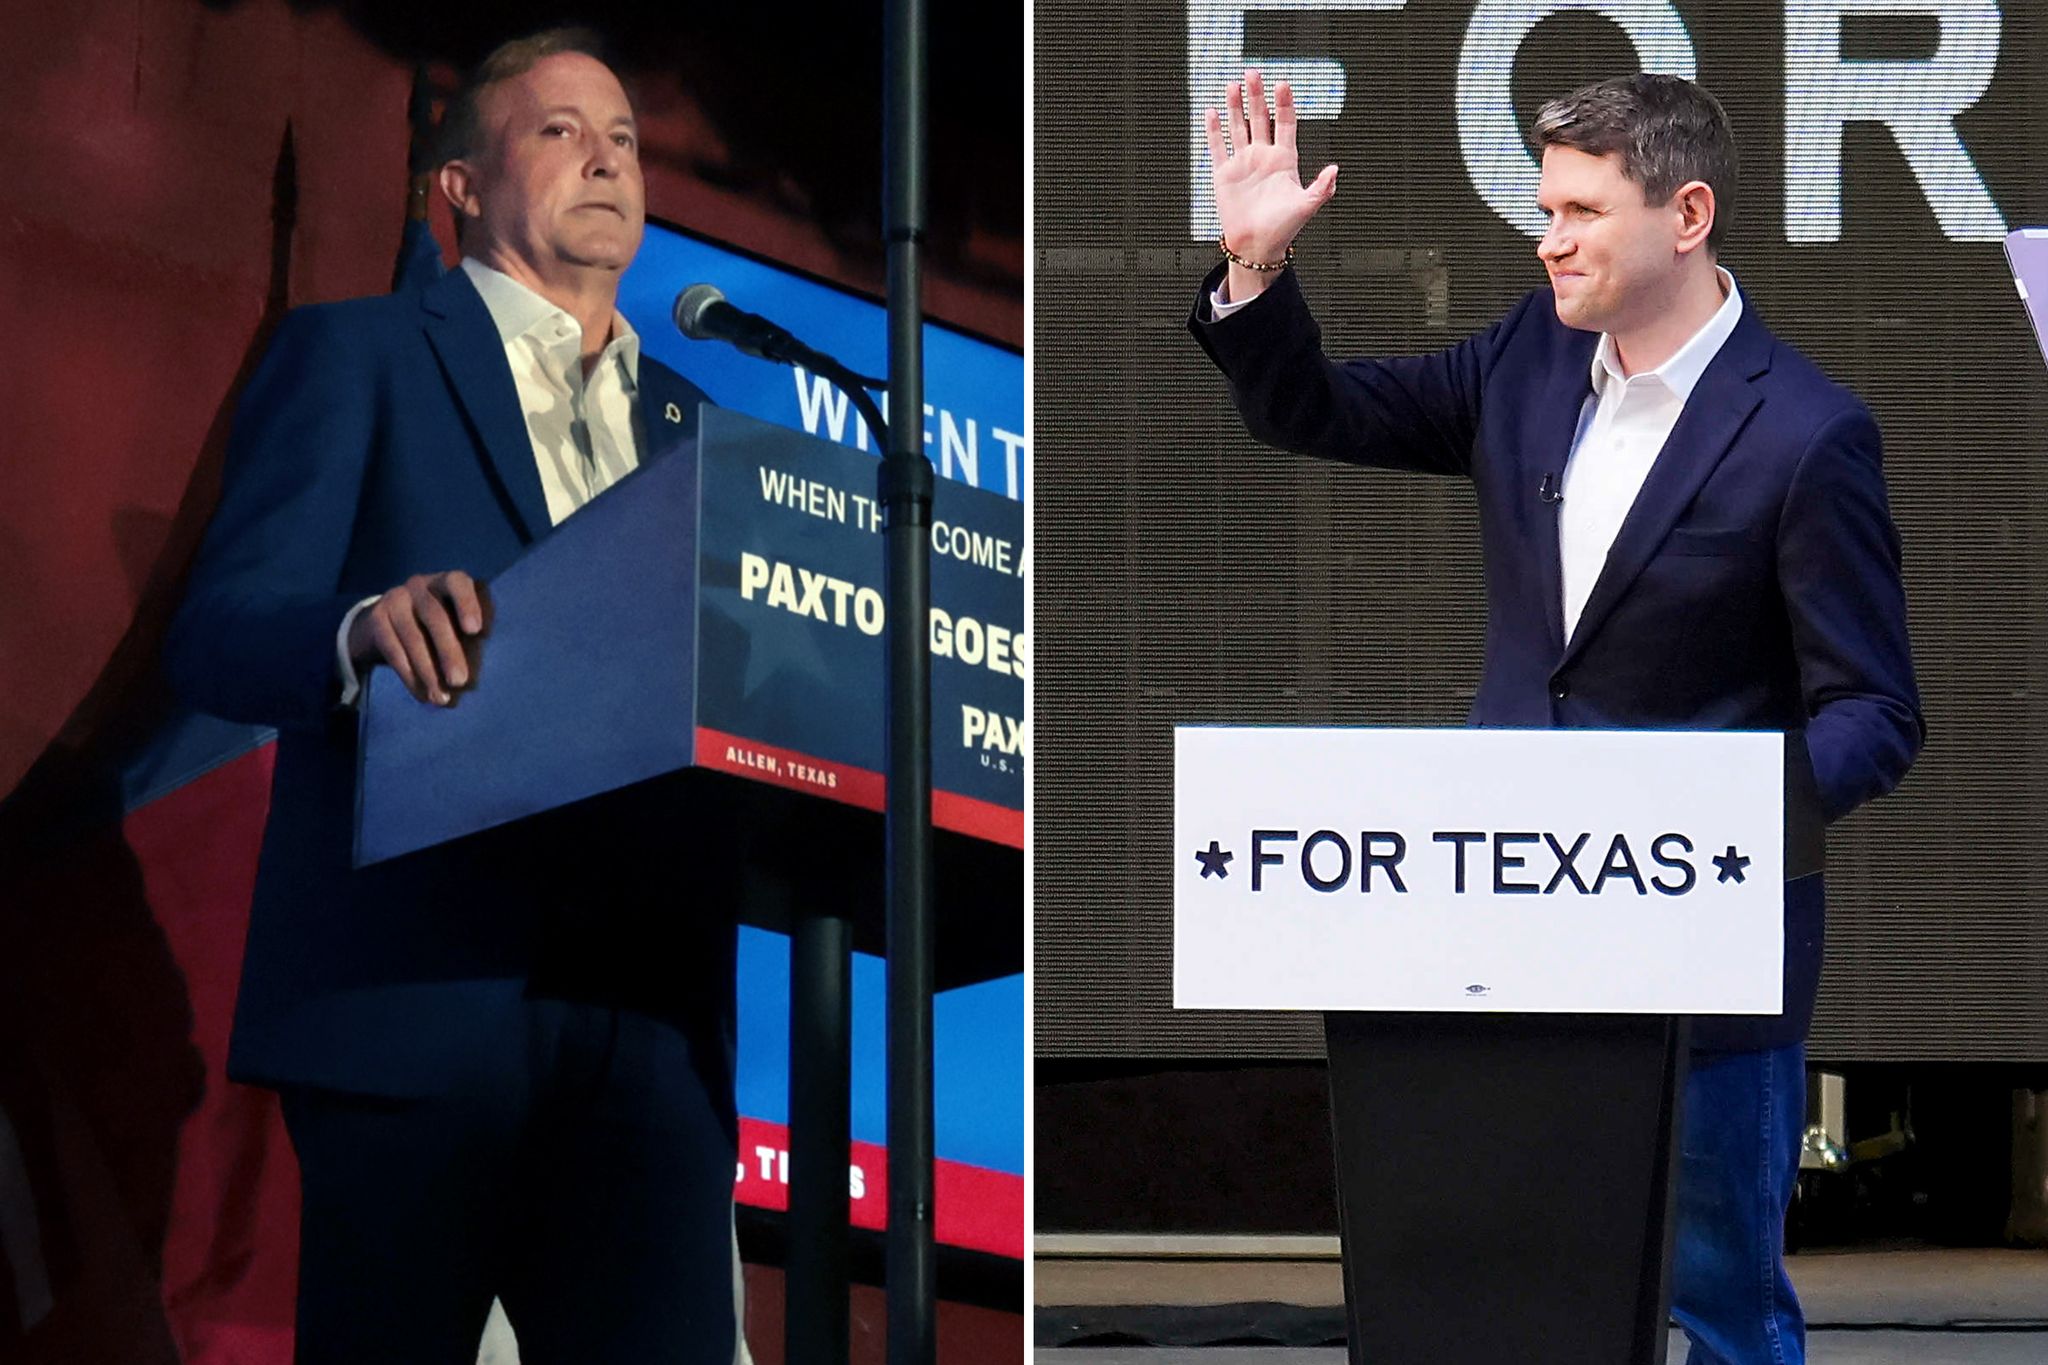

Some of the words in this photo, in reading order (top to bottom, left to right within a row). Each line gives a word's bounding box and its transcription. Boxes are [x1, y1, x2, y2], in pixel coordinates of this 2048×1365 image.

[1186, 0, 2008, 244] FOR
[759, 466, 845, 524] WHEN
[931, 520, 1012, 575] COME
[741, 551, 885, 636] PAXTO
[726, 746, 782, 777] ALLEN,
[787, 761, 837, 788] TEXAS
[1252, 829, 1408, 893] FOR
[1432, 831, 1697, 896] TEXAS
